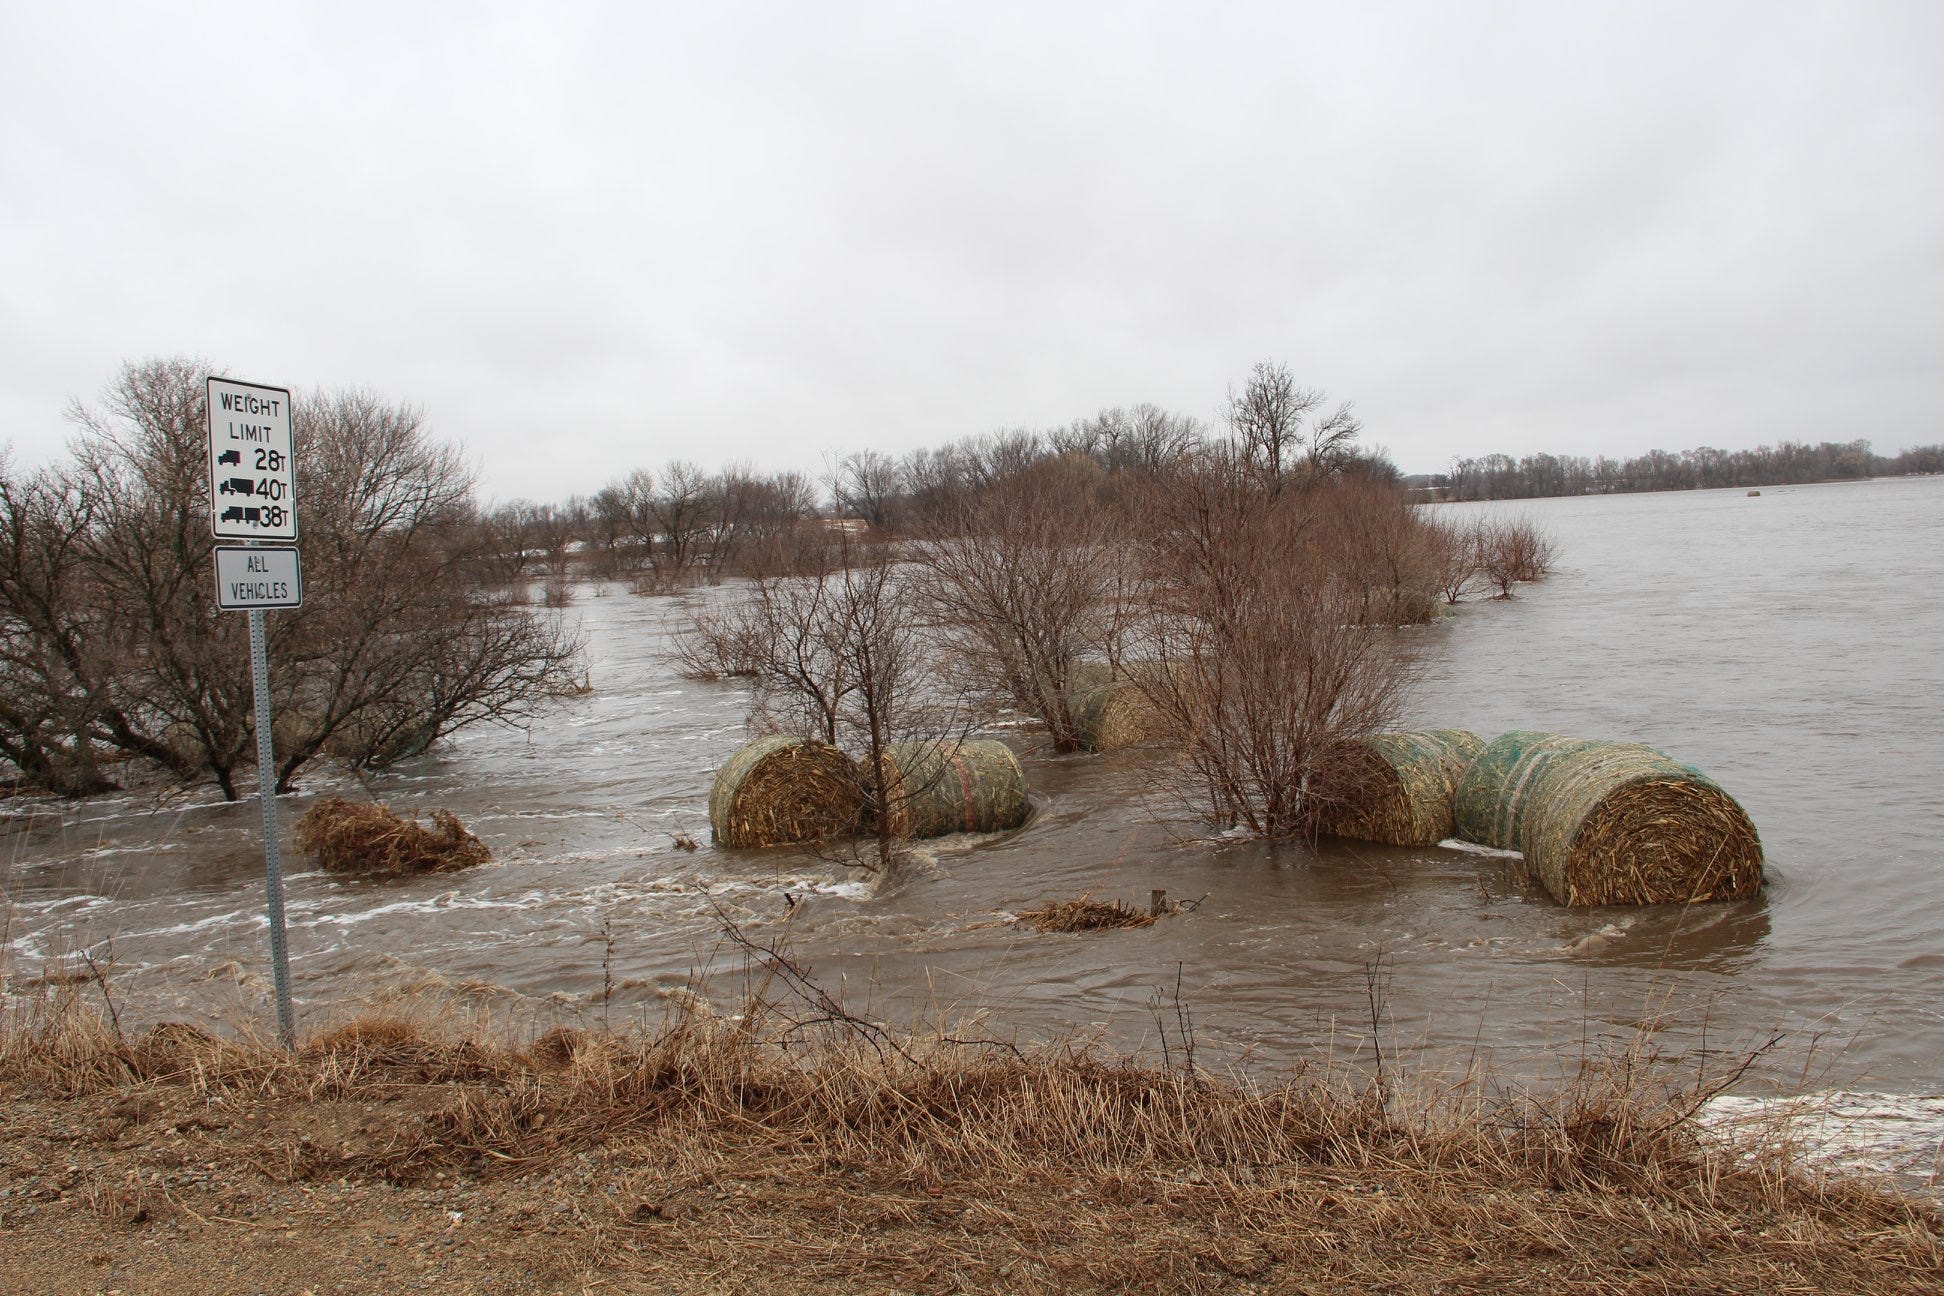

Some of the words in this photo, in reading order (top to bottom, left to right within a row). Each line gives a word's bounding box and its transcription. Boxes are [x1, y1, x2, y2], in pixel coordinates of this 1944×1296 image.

[221, 393, 279, 417] WEIGHT
[230, 422, 271, 443] LIMIT
[248, 556, 269, 573] ALL
[231, 582, 288, 600] VEHICLES
